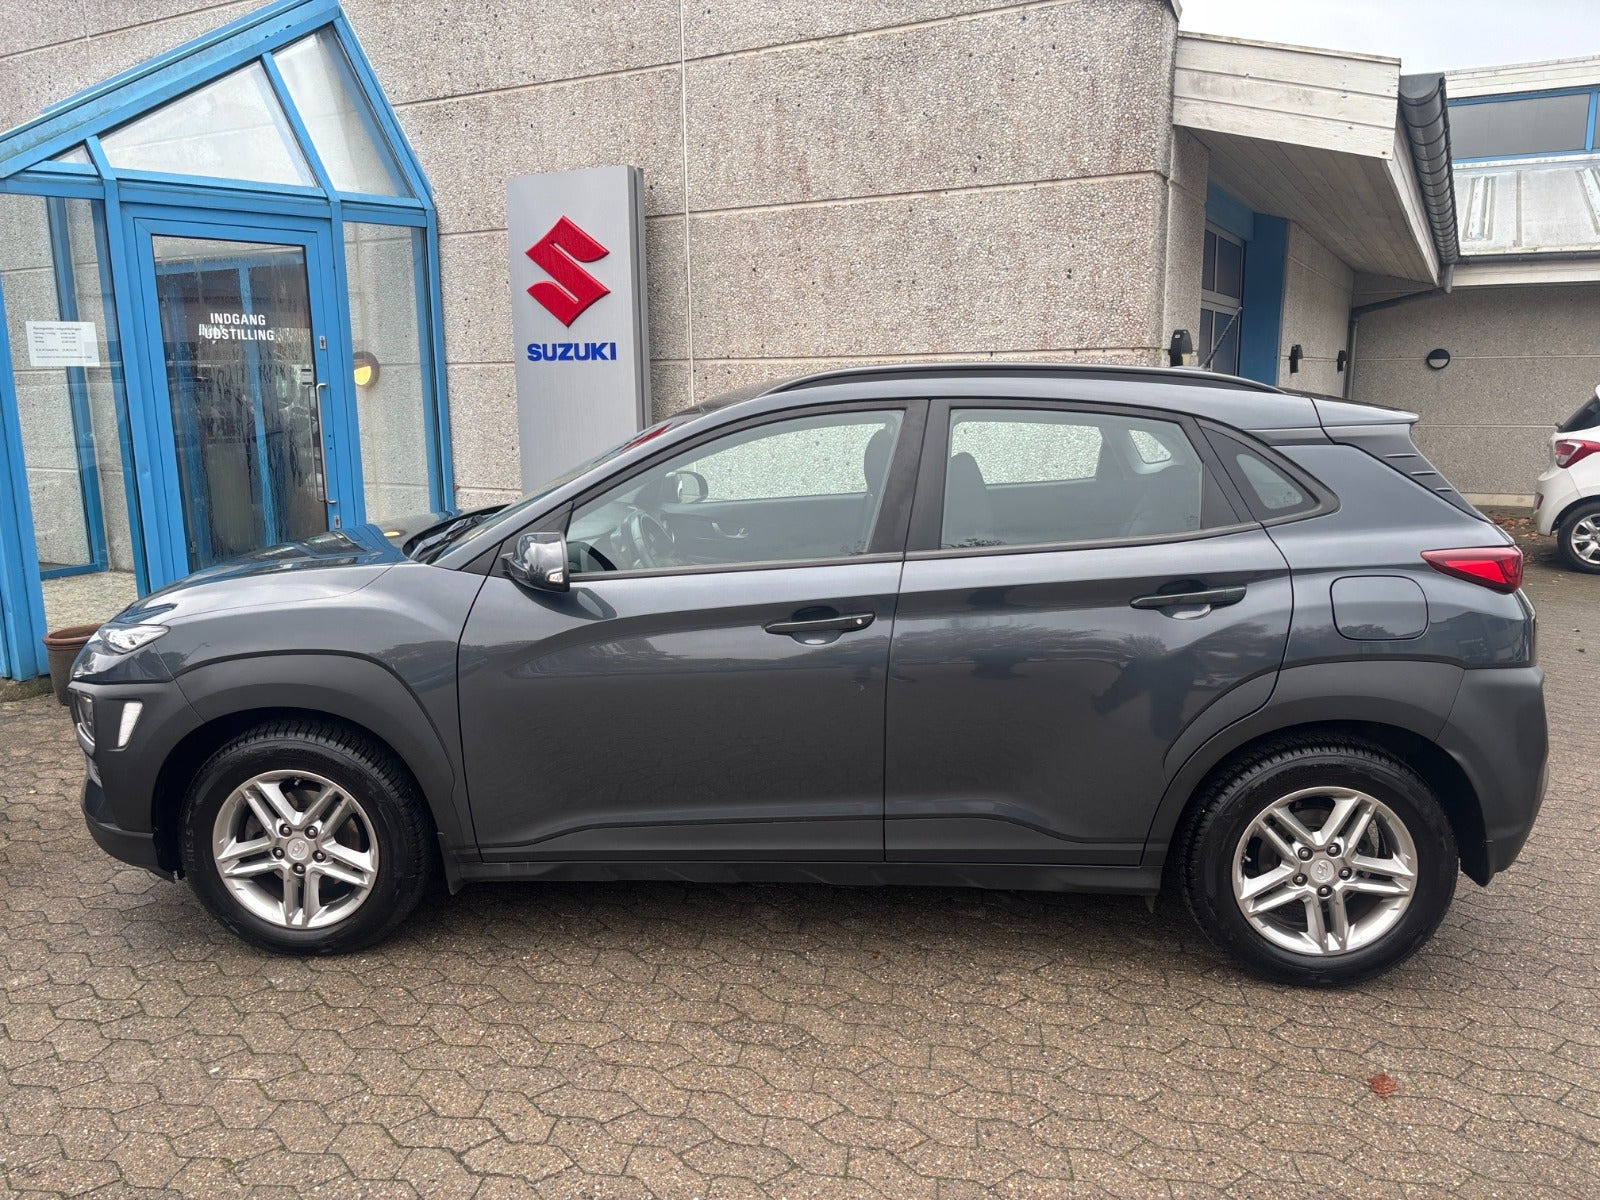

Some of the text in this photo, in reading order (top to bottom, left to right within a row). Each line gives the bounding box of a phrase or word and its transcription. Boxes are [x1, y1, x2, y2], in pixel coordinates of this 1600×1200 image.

[210, 312, 266, 326] INDGANG
[204, 327, 275, 341] UDSTILLING
[527, 342, 617, 361] SUZUKI
